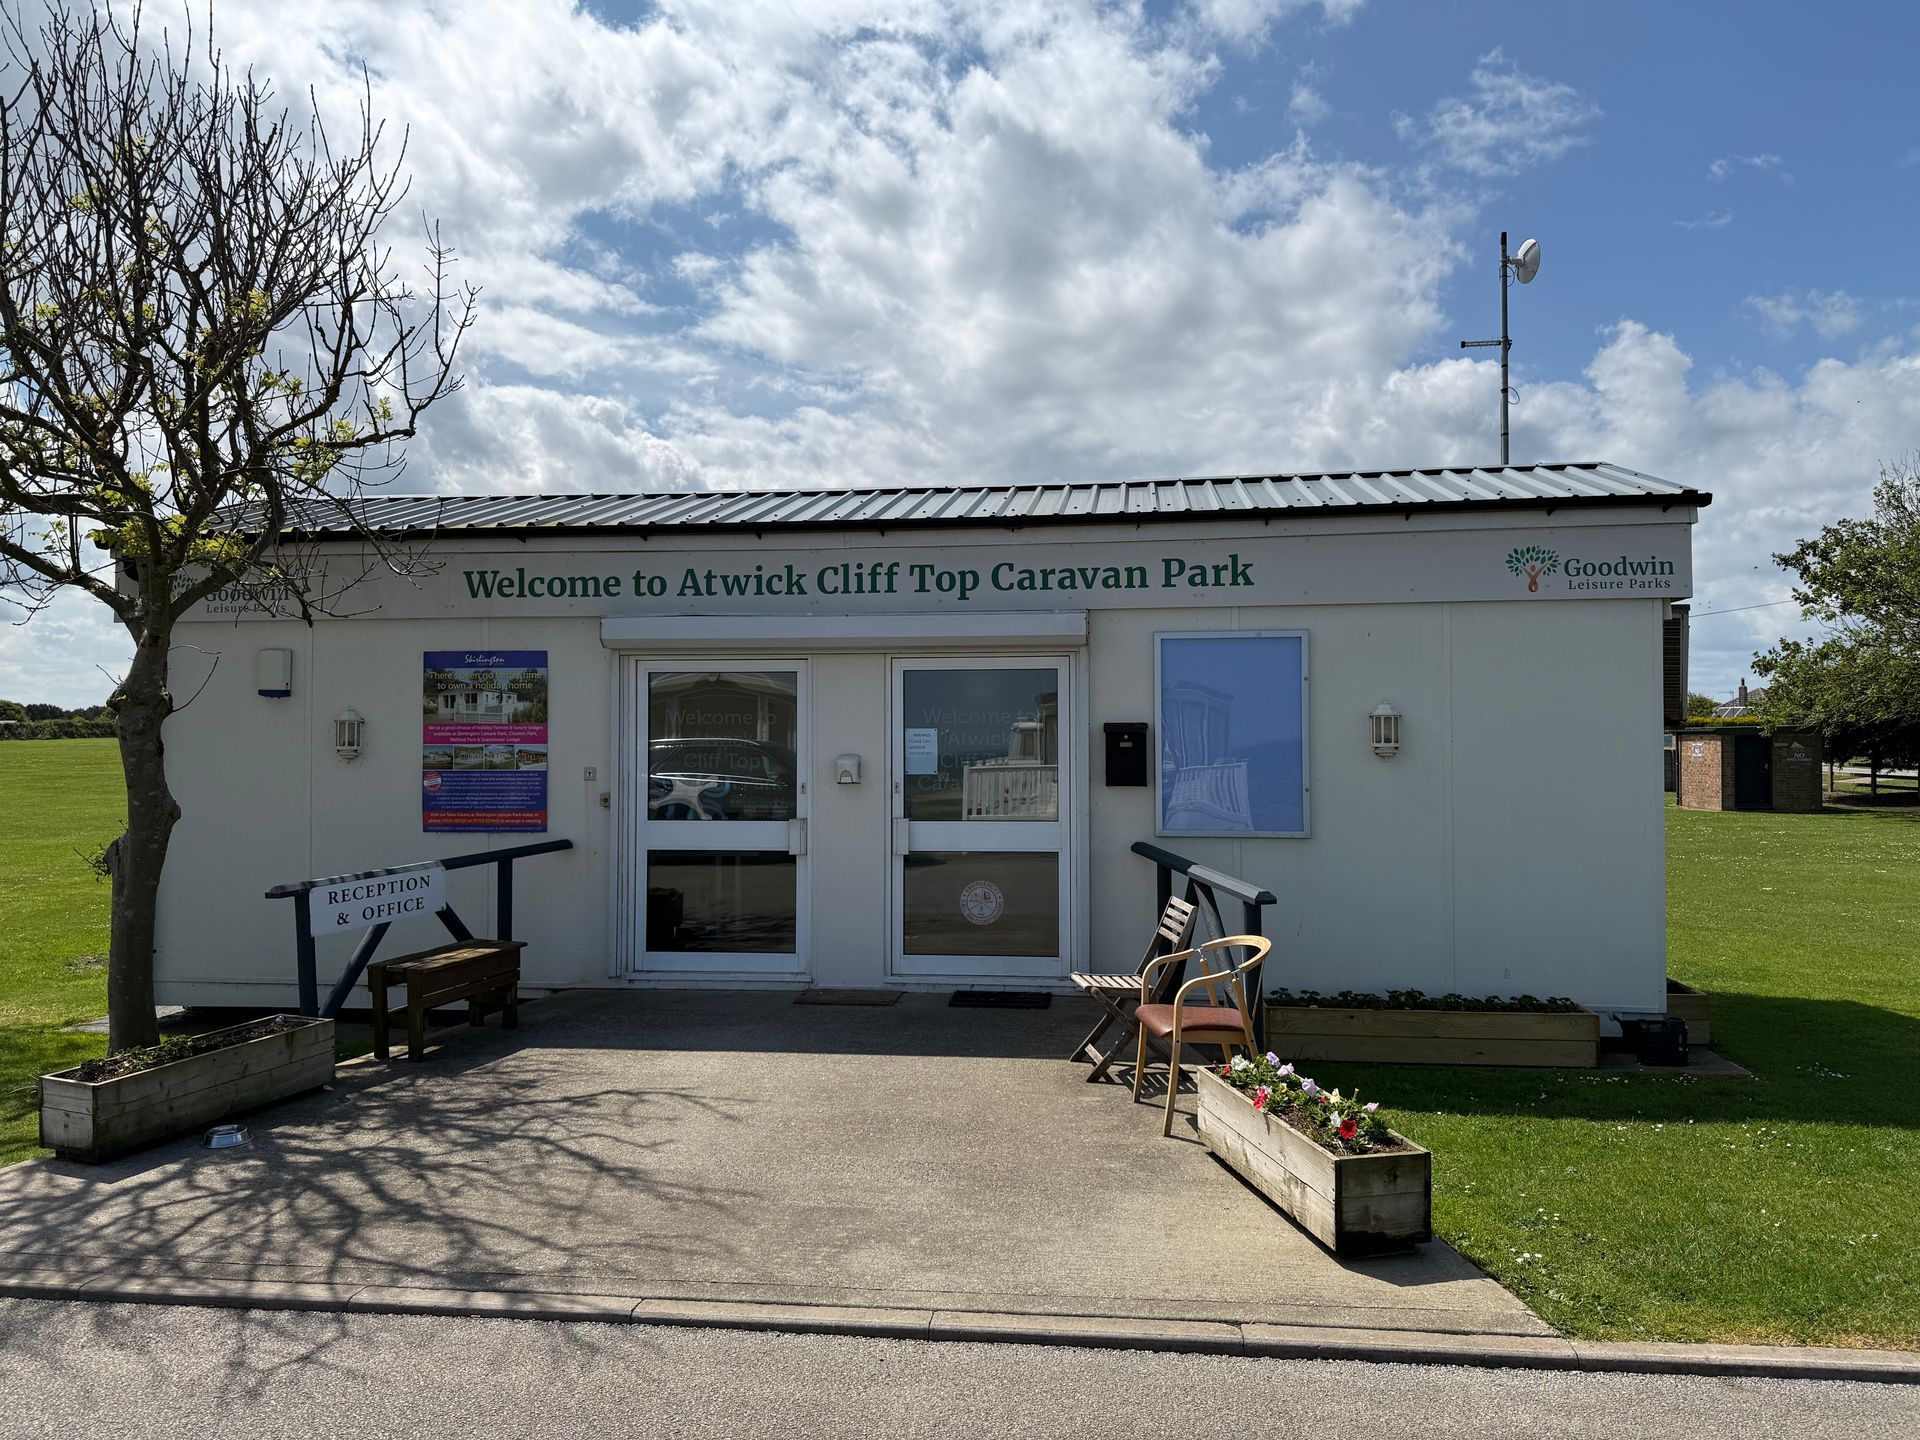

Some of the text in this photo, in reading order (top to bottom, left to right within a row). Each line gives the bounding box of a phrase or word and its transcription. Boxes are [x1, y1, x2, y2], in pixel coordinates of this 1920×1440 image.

[1563, 555, 1675, 577] Goodwin
[463, 553, 1255, 601] Welcome to Atwick Cliff Top Caravan Park
[1568, 578, 1671, 590] Leisure Parks
[206, 604, 249, 614] Leisure
[523, 671, 542, 679] time
[437, 682, 446, 690] to
[475, 681, 506, 692] holiday
[508, 681, 533, 690] home
[666, 708, 753, 725] Welcome
[922, 706, 1012, 724] Welcome
[684, 753, 761, 772] Cliff Top
[328, 874, 431, 906] RECEPTION
[336, 896, 425, 926] & OFFICE
